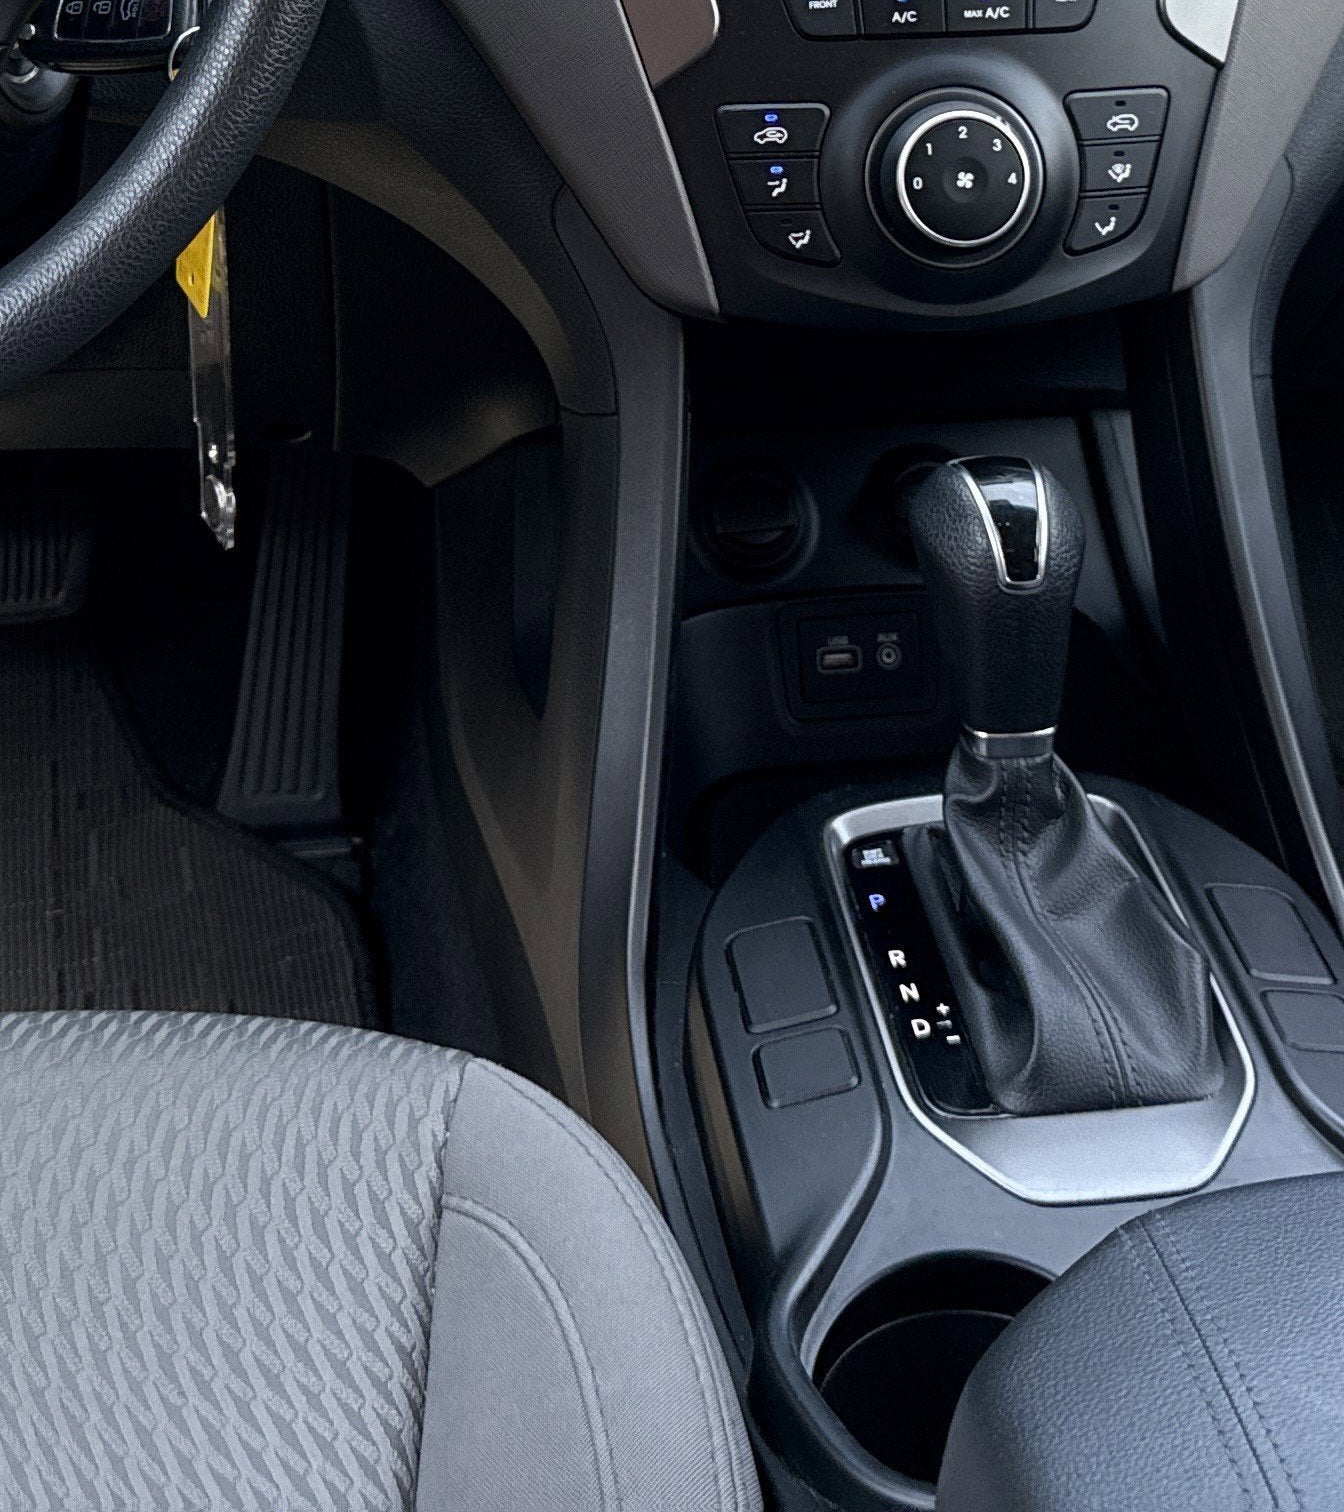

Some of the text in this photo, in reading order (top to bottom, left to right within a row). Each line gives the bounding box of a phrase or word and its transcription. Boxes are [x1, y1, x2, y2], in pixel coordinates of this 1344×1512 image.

[808, 0, 839, 10] FRONT
[891, 11, 918, 23] A/C
[963, 6, 1010, 20] MAX A/C
[958, 126, 968, 139] 2
[925, 142, 933, 156] 1
[992, 139, 1003, 152] 3
[912, 177, 923, 190] 0
[1007, 173, 1017, 185] 4
[868, 893, 886, 912] P
[888, 949, 907, 969] R
[898, 982, 921, 1003] N
[910, 1018, 932, 1039] D
